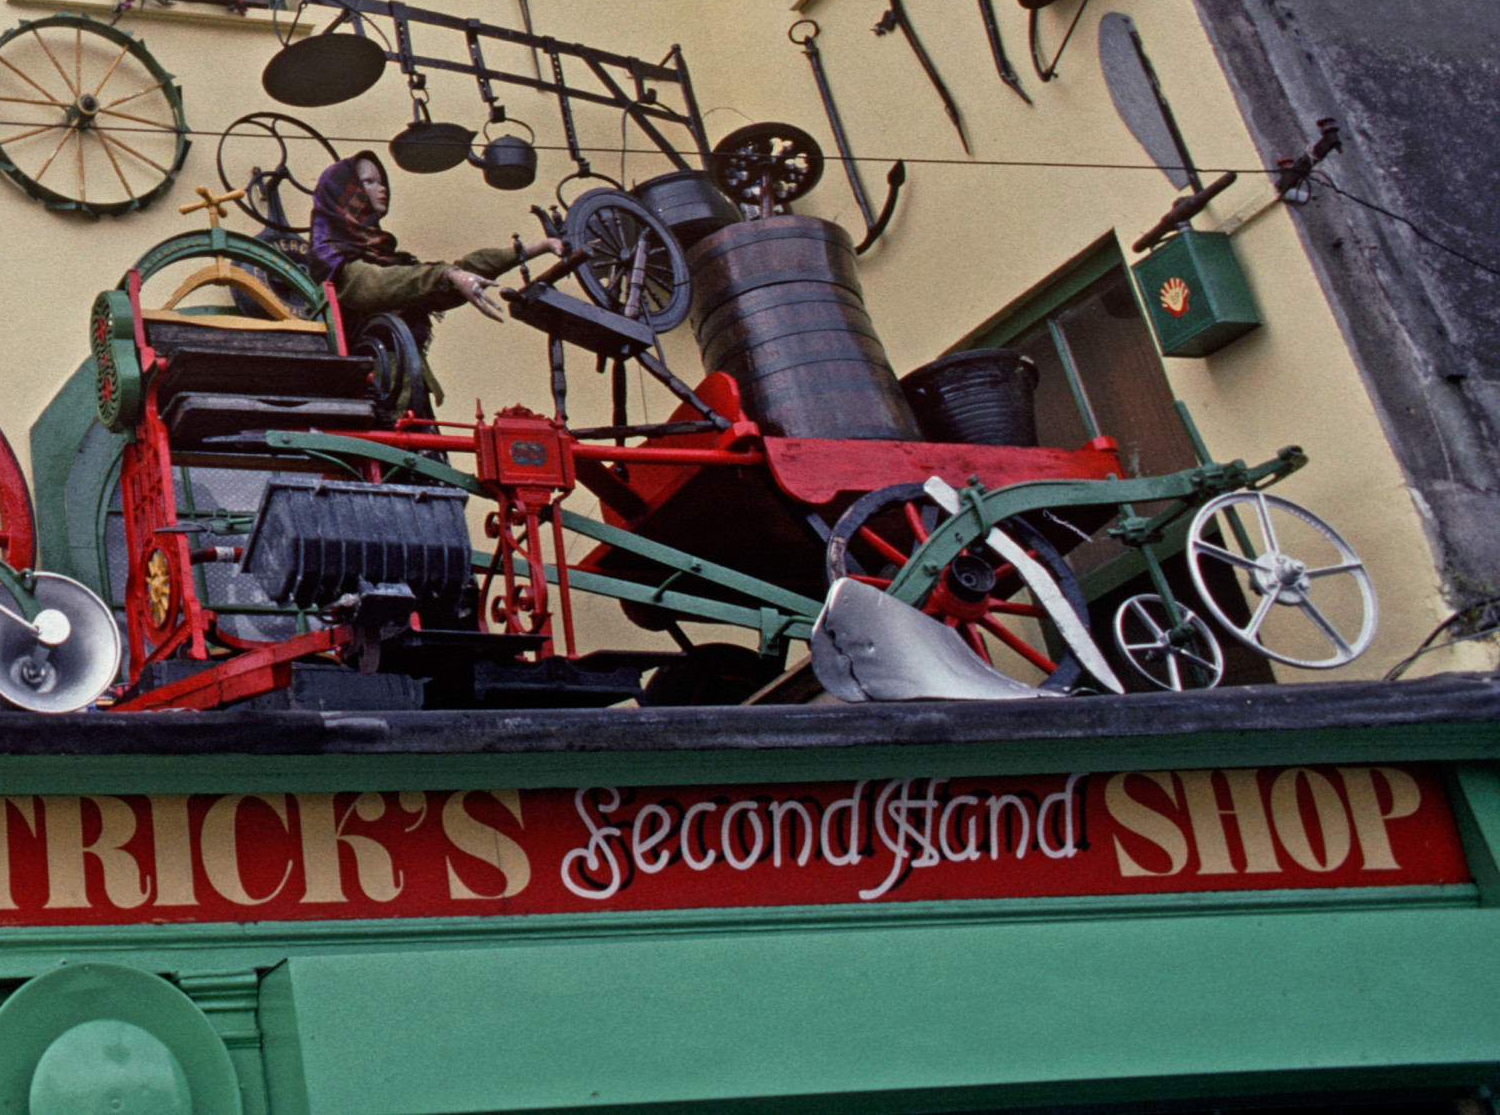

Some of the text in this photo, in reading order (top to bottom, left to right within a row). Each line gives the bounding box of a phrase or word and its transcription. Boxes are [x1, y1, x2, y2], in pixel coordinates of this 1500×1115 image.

[561, 780, 868, 900] Second
[859, 772, 1089, 900] Hand
[1104, 767, 1422, 877] SHOP
